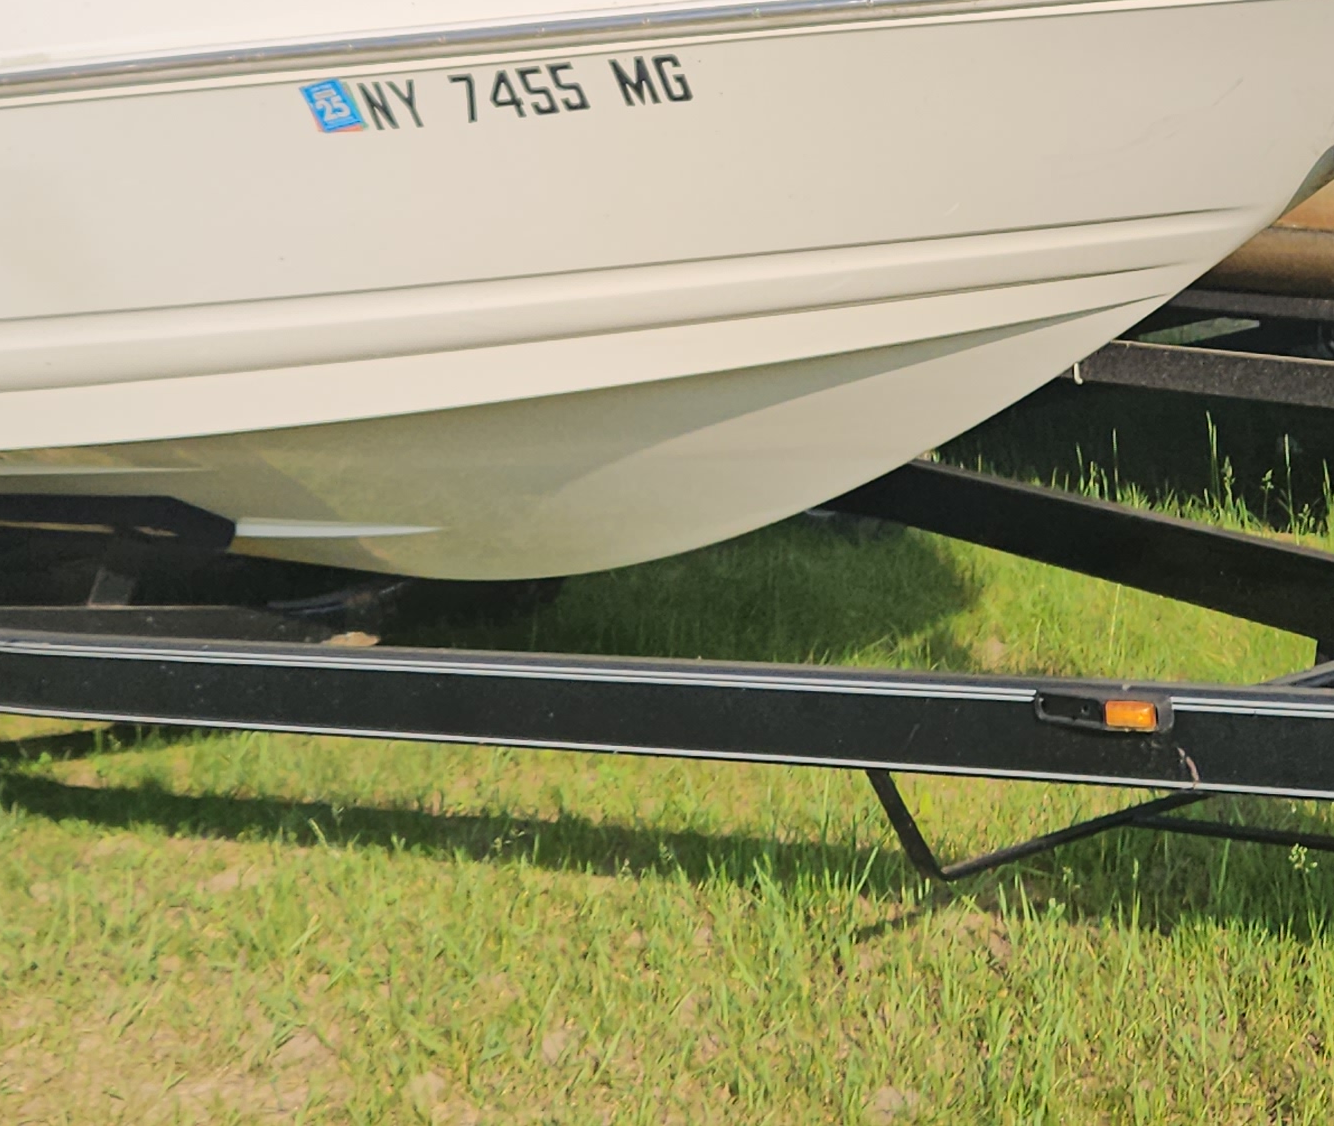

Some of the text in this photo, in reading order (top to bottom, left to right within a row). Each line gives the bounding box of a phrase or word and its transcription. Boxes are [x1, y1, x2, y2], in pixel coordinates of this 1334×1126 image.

[314, 94, 352, 122] 25
[357, 53, 694, 131] NY 7455 MG
